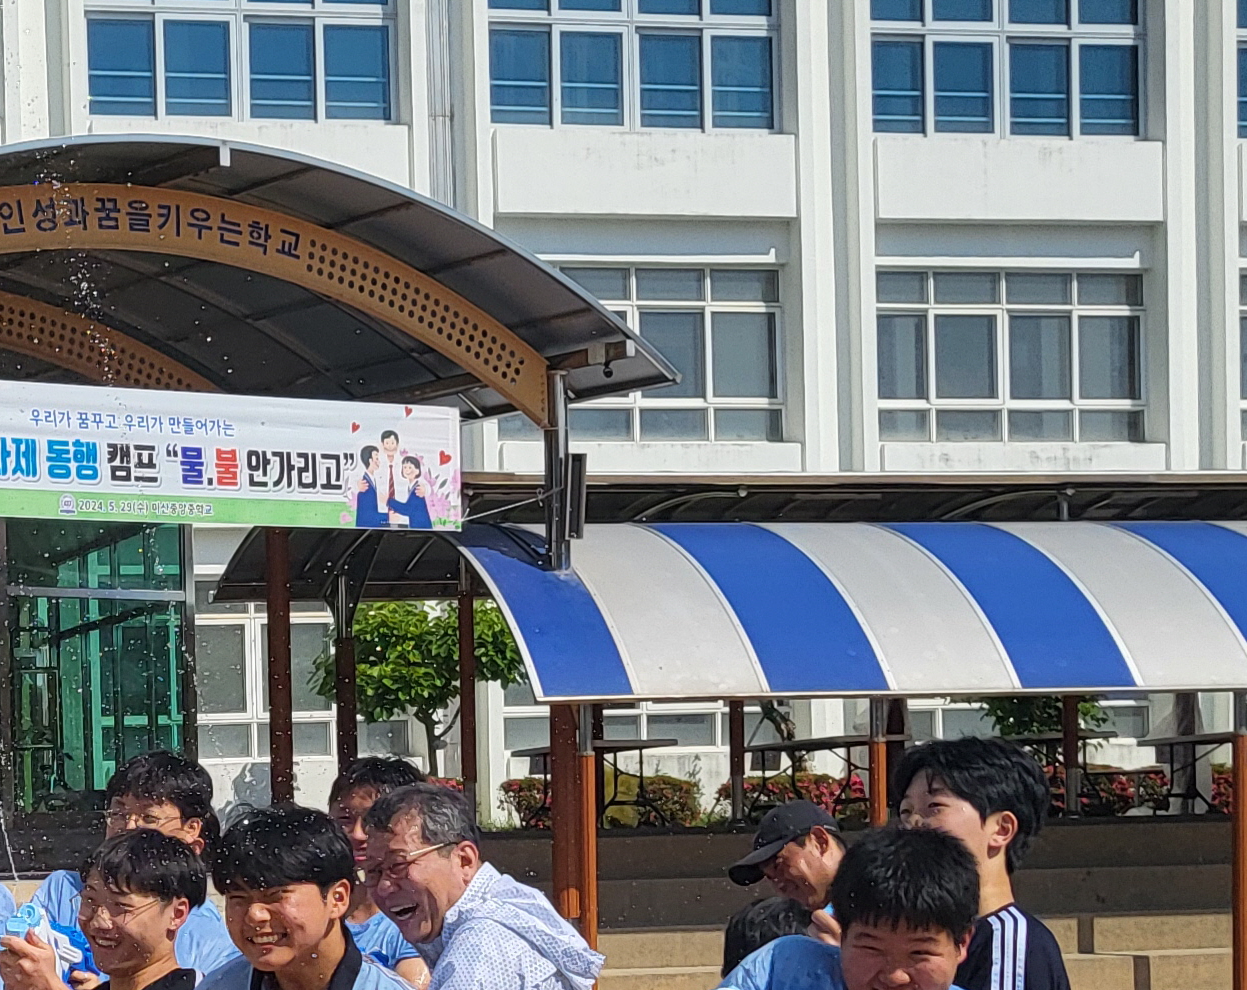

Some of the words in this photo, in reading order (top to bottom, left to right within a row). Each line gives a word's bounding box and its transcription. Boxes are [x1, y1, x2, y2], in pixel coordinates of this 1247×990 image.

[29, 408, 72, 428] 우리가
[76, 411, 119, 430] 꿈꾸고
[122, 413, 164, 433] 우리가
[168, 416, 235, 437] 만들어가는
[46, 438, 100, 481] 동행
[106, 443, 157, 484] 캠프
[78, 500, 106, 512] 2024.
[108, 502, 119, 512] 5.
[120, 502, 149, 515] 29(수)
